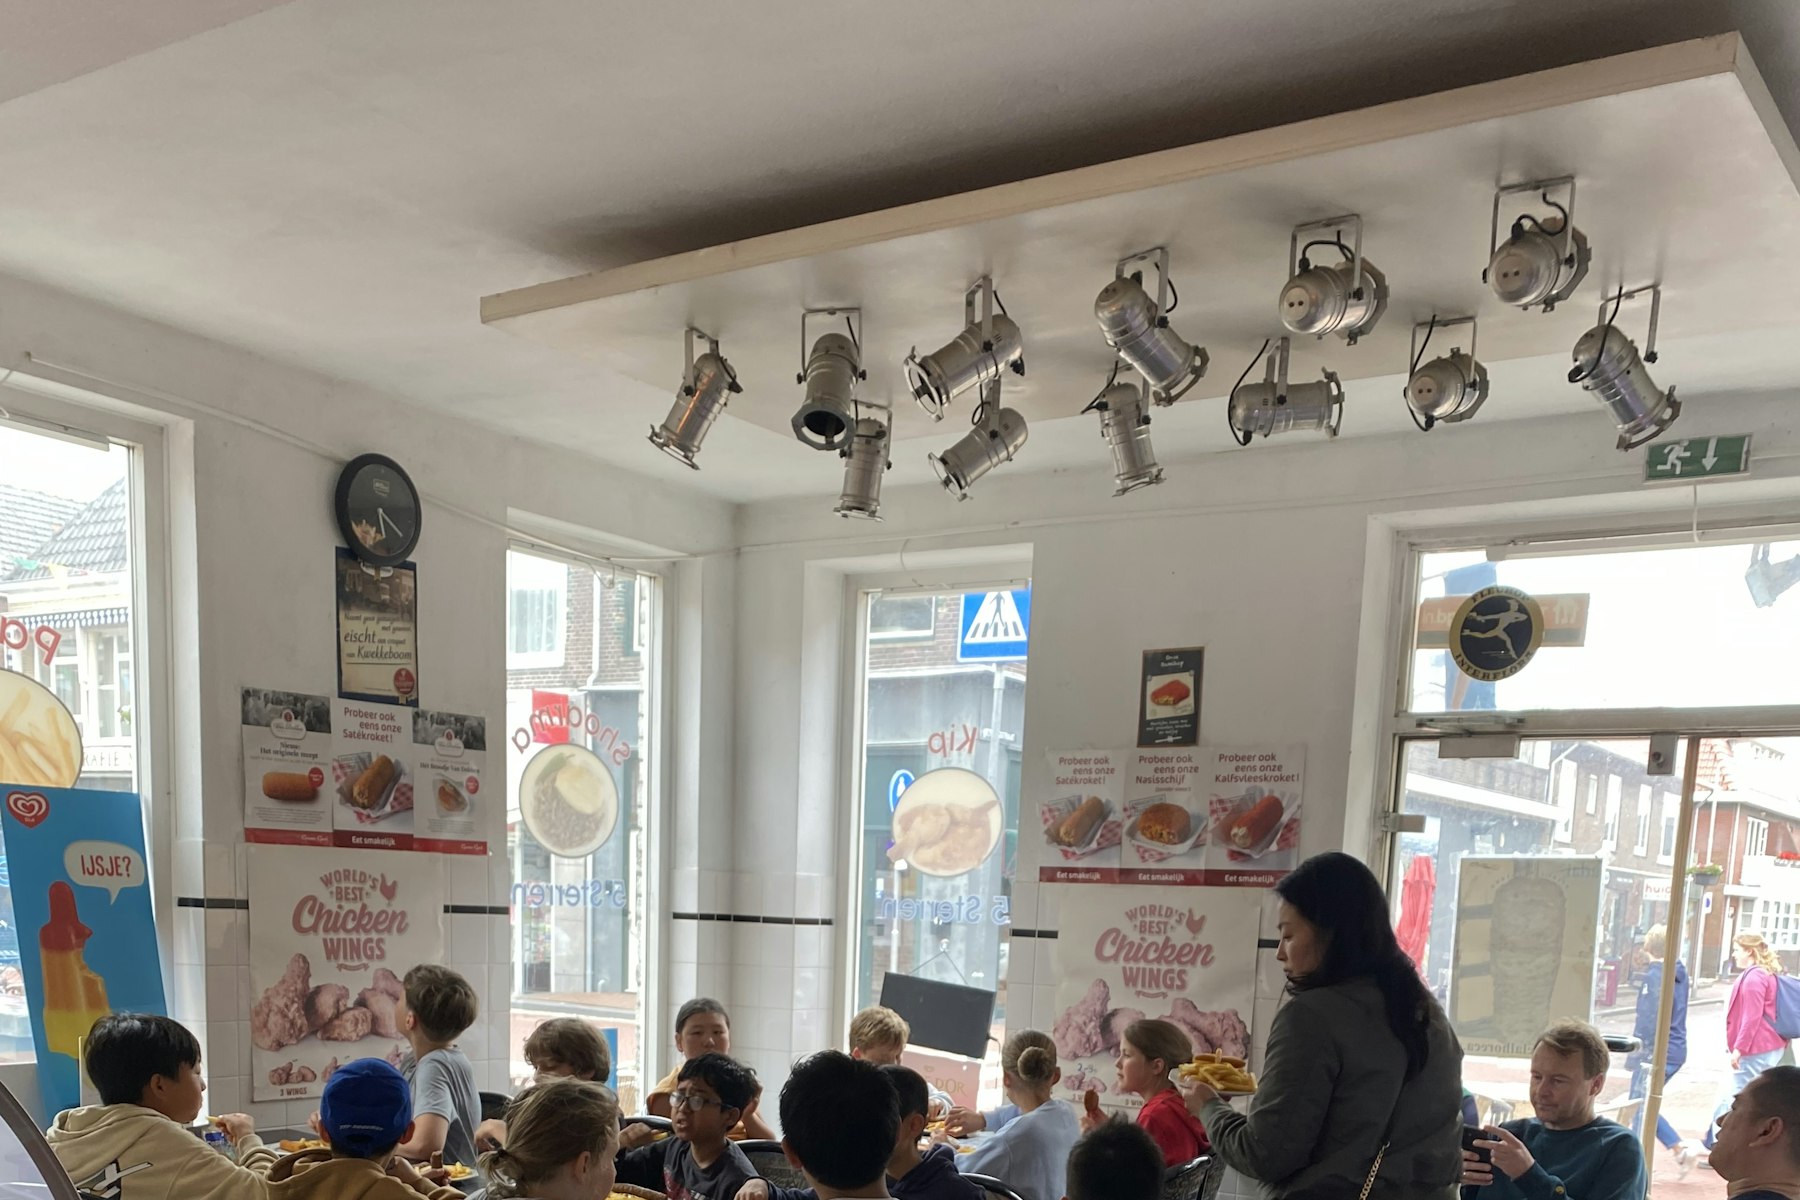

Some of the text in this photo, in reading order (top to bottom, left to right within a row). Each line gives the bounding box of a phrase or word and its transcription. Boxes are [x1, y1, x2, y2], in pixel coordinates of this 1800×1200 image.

[344, 707, 396, 721] Probeer ook
[360, 720, 402, 733] eens onze
[343, 729, 393, 743] Satékroket!
[1059, 756, 1110, 765] Probeer ook
[1139, 754, 1193, 764] Probeer ook
[1218, 753, 1276, 762] Probeer ook
[1154, 765, 1199, 774] eens onze
[1259, 764, 1283, 772] onze
[1056, 775, 1105, 785] Satékroket!
[352, 836, 395, 846] Eet smakelijk
[81, 854, 131, 878] IJSJE?
[320, 868, 379, 890] WORLD'S
[1068, 872, 1100, 881] smakelijk
[1151, 873, 1185, 882] smakelijk
[1225, 874, 1274, 884] Eet smakelijk
[335, 886, 364, 901] BEST
[292, 895, 409, 935] Chicken
[1125, 904, 1186, 926] WORLD'S
[1138, 920, 1168, 935] BEST
[322, 937, 385, 961] WINGS
[1095, 927, 1216, 967] Chicken
[1122, 966, 1188, 991] WINGS
[286, 1087, 307, 1096] WINGS
